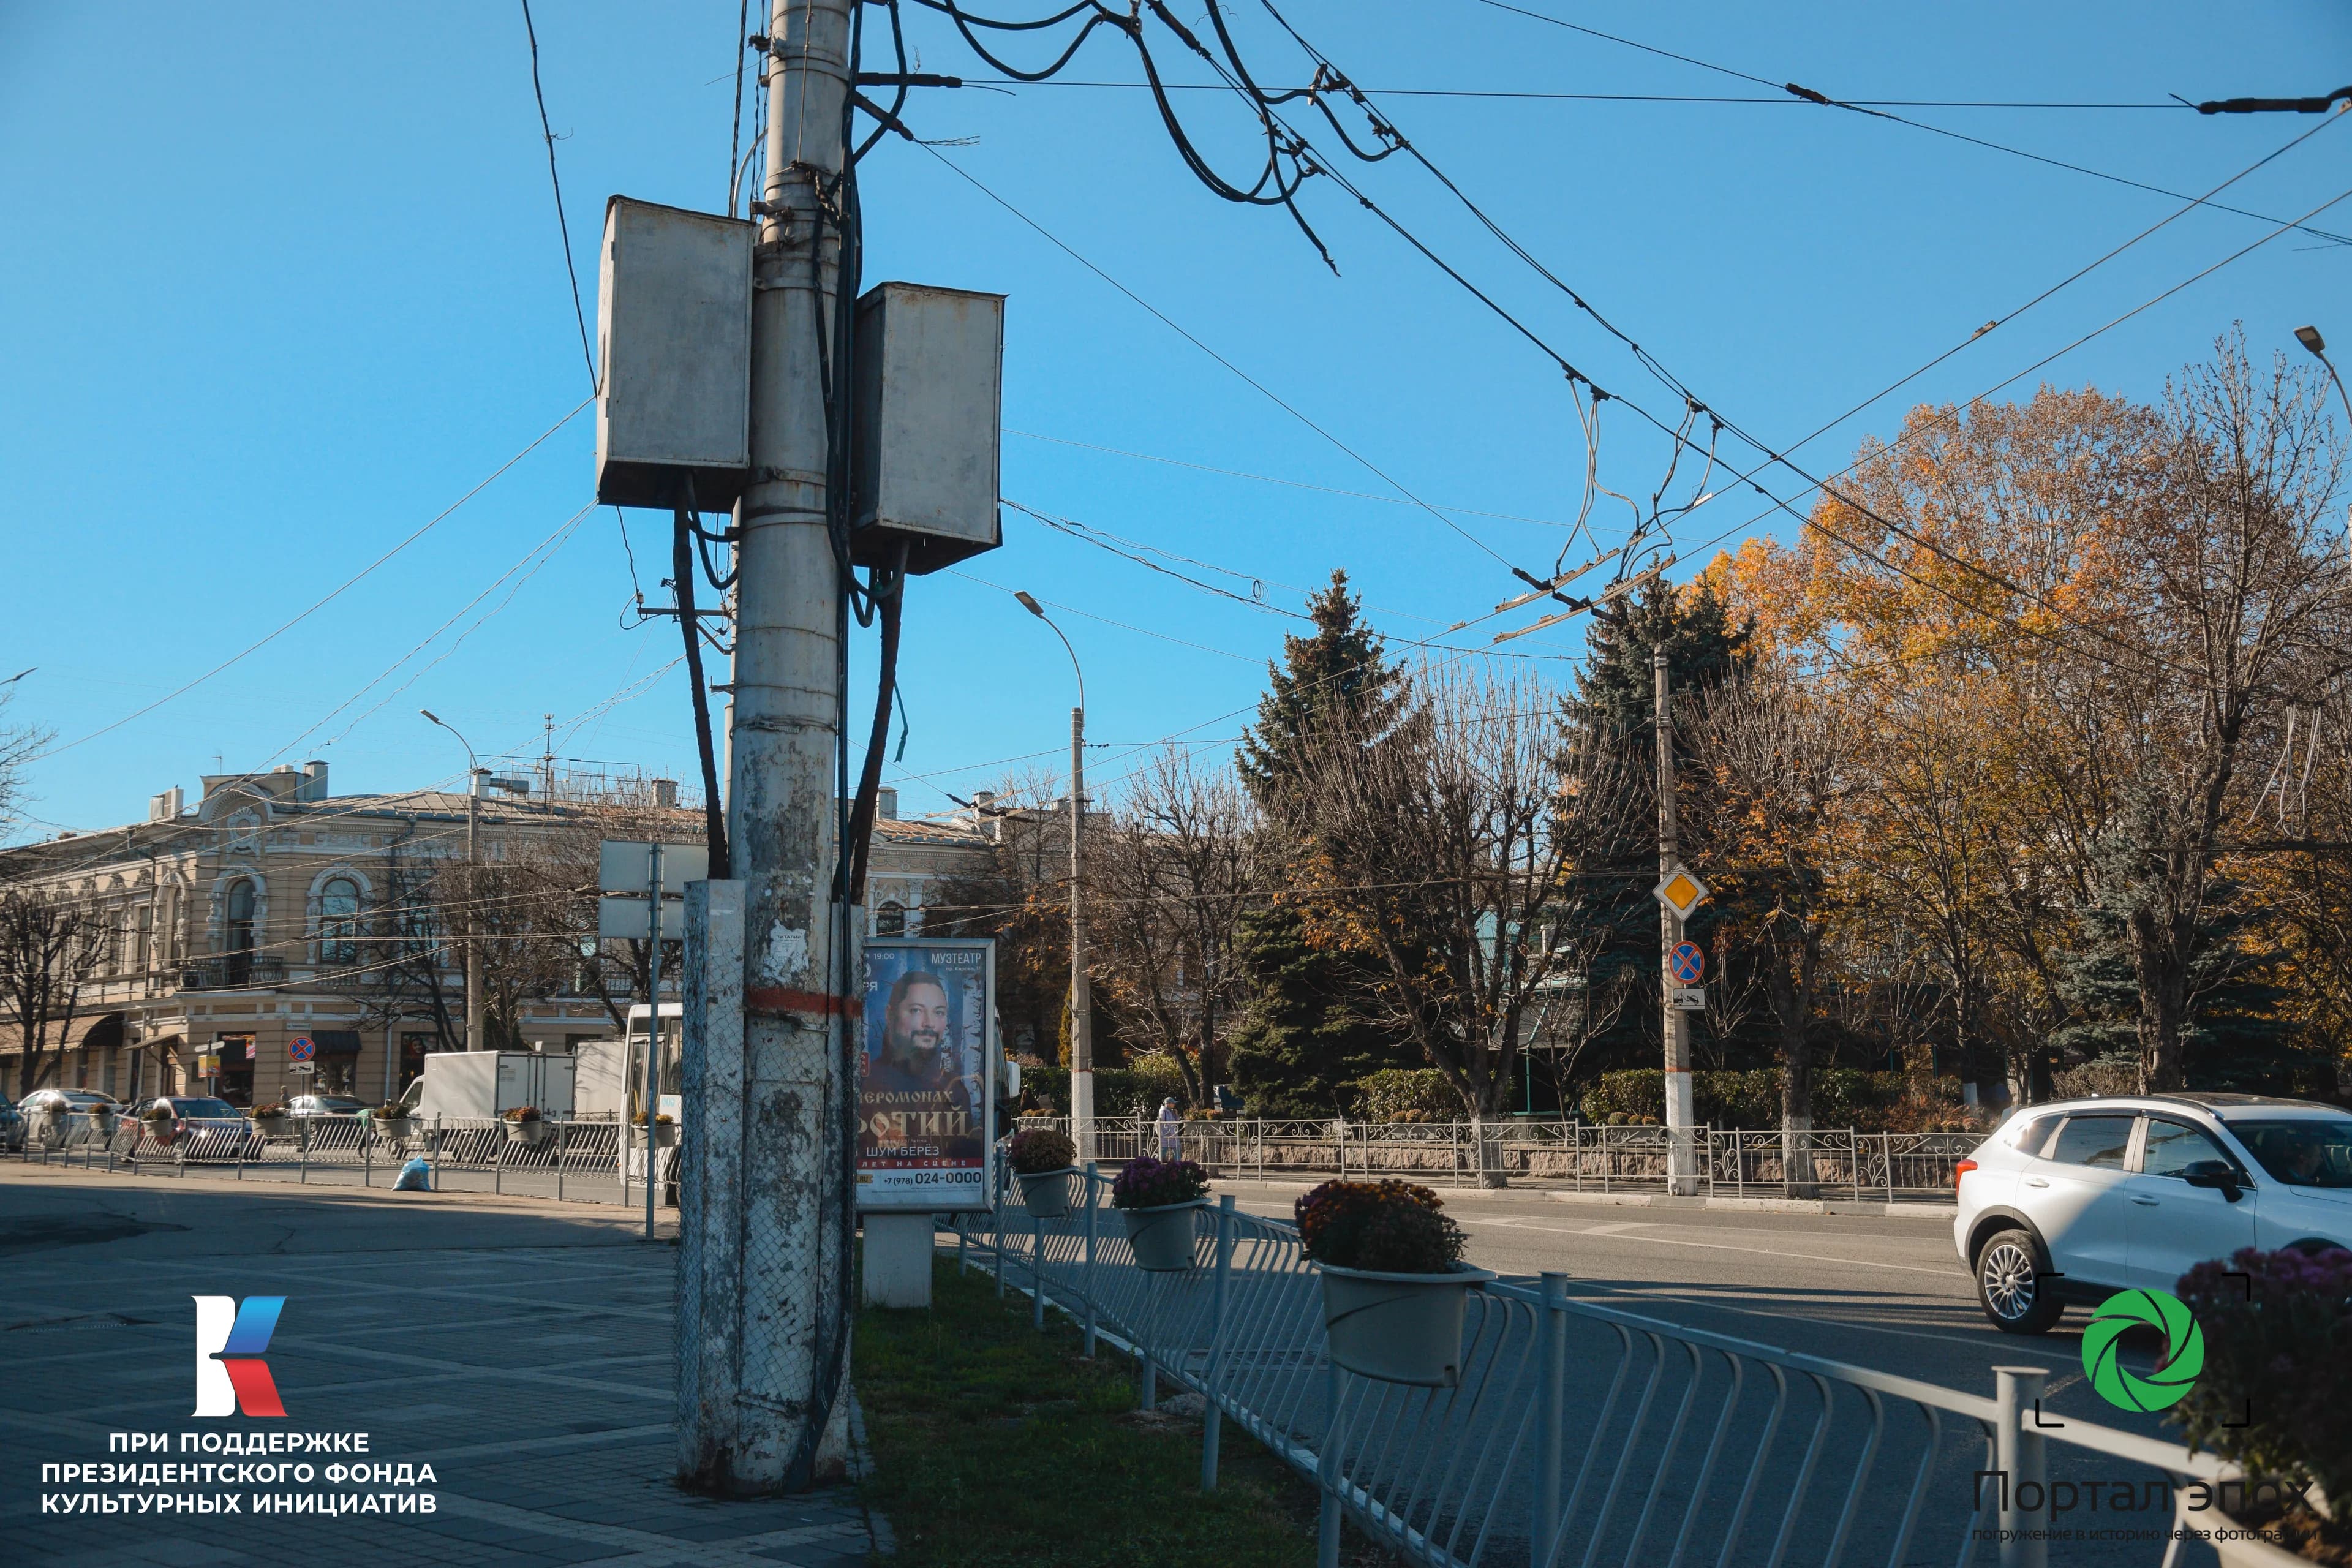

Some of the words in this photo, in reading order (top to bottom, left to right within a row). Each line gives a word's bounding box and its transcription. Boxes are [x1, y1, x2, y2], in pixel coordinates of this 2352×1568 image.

[932, 952, 981, 964] МУЗТЕАТР
[867, 1147, 897, 1156] ШУМ
[900, 1144, 939, 1156] БЕРЁЗ
[893, 1177, 913, 1186] (978)
[915, 1172, 981, 1184] 024-0000
